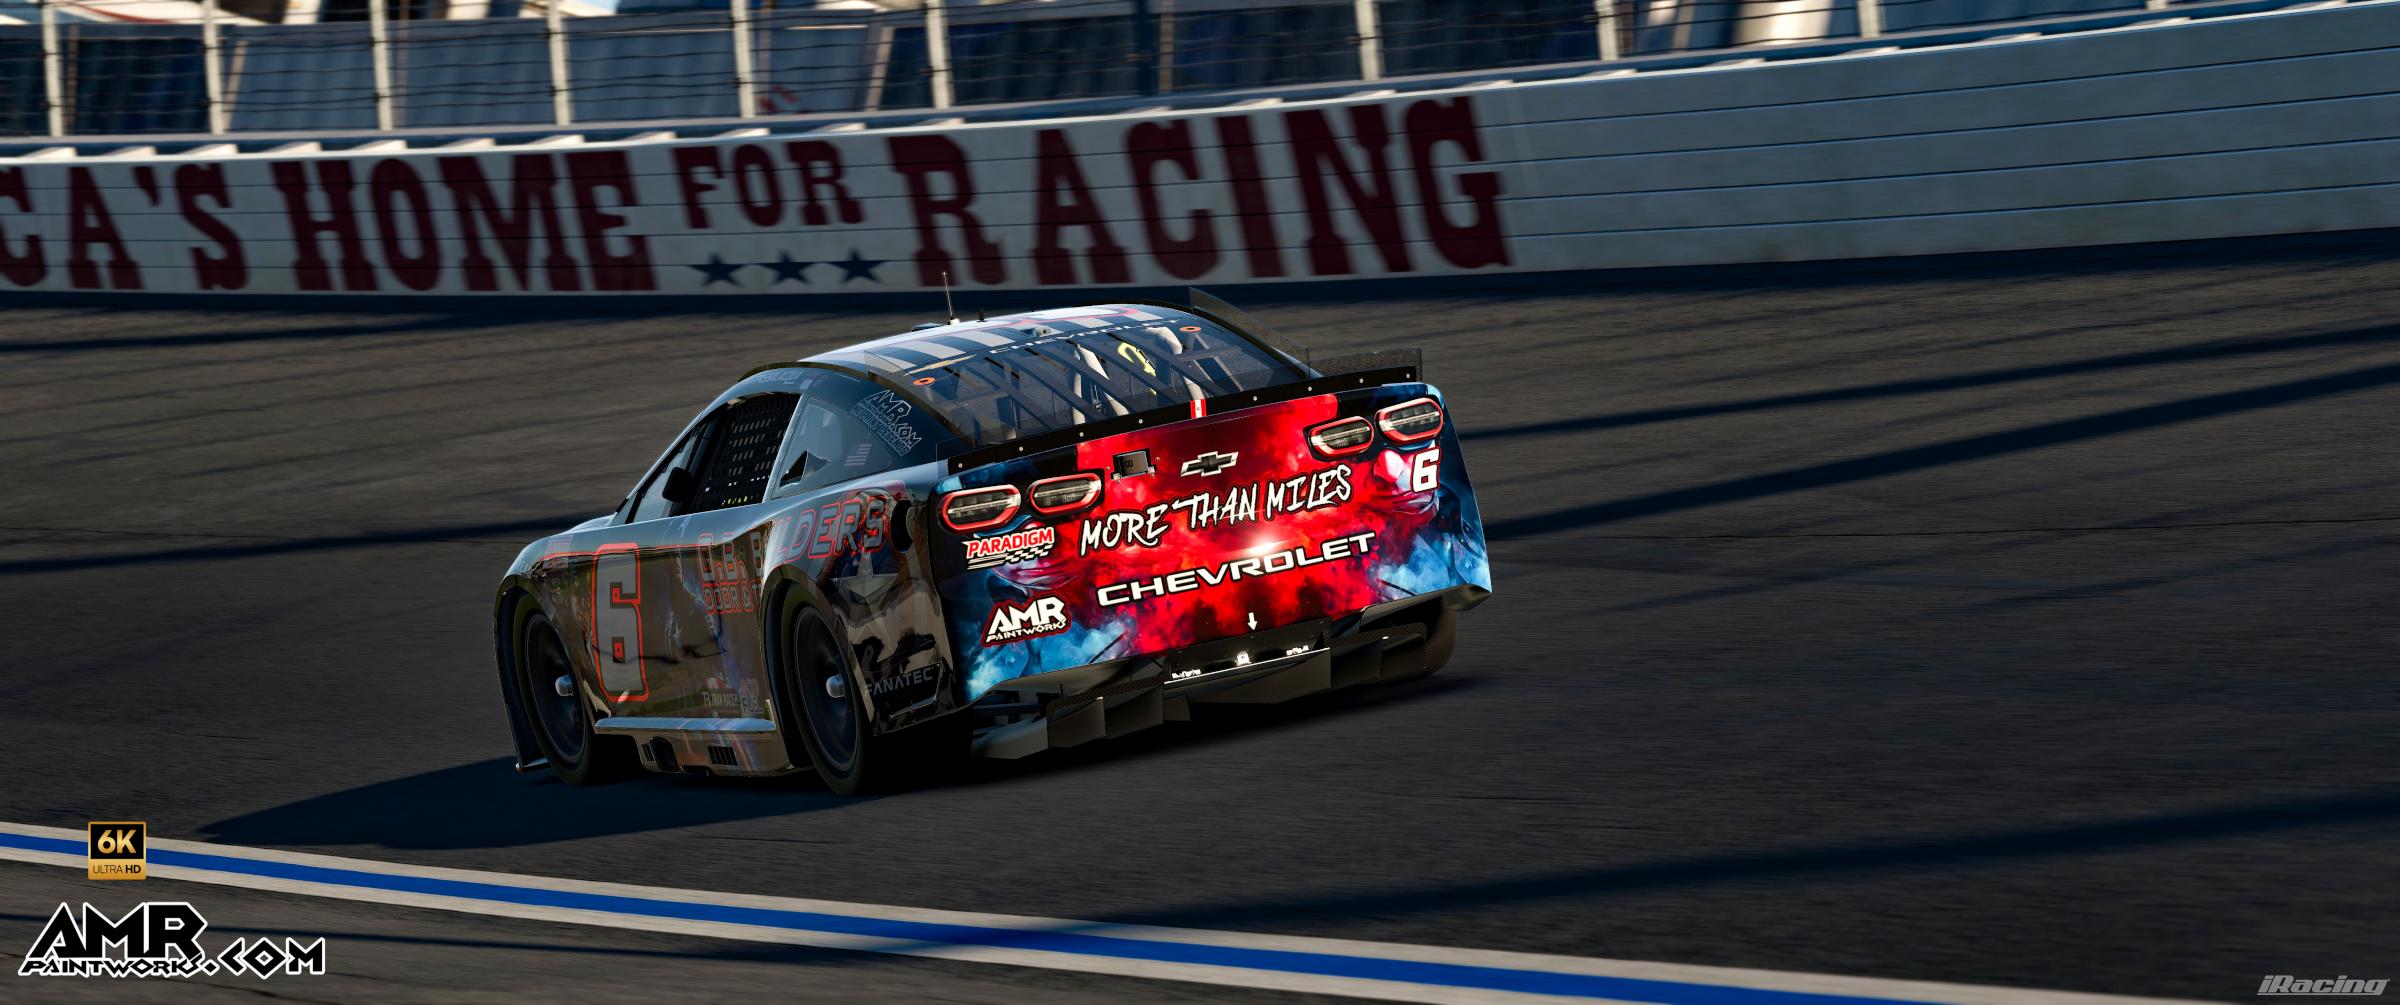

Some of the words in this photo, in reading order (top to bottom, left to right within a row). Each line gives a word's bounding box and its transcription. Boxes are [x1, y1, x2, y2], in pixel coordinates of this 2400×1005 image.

[268, 149, 660, 292] HOME
[672, 138, 865, 230] FOR
[887, 95, 1513, 288] RACING
[1411, 447, 1441, 492] 6
[1079, 509, 1170, 556] MORE
[1170, 488, 1257, 531] THAN
[1265, 463, 1352, 518] MILES
[966, 527, 1054, 559] PARADIGM
[1098, 532, 1376, 608] CHEVROLET
[592, 542, 649, 702] 6
[985, 620, 1067, 643] PAINTWORKS
[987, 597, 1066, 634] AMR
[866, 666, 935, 696] FANATEC
